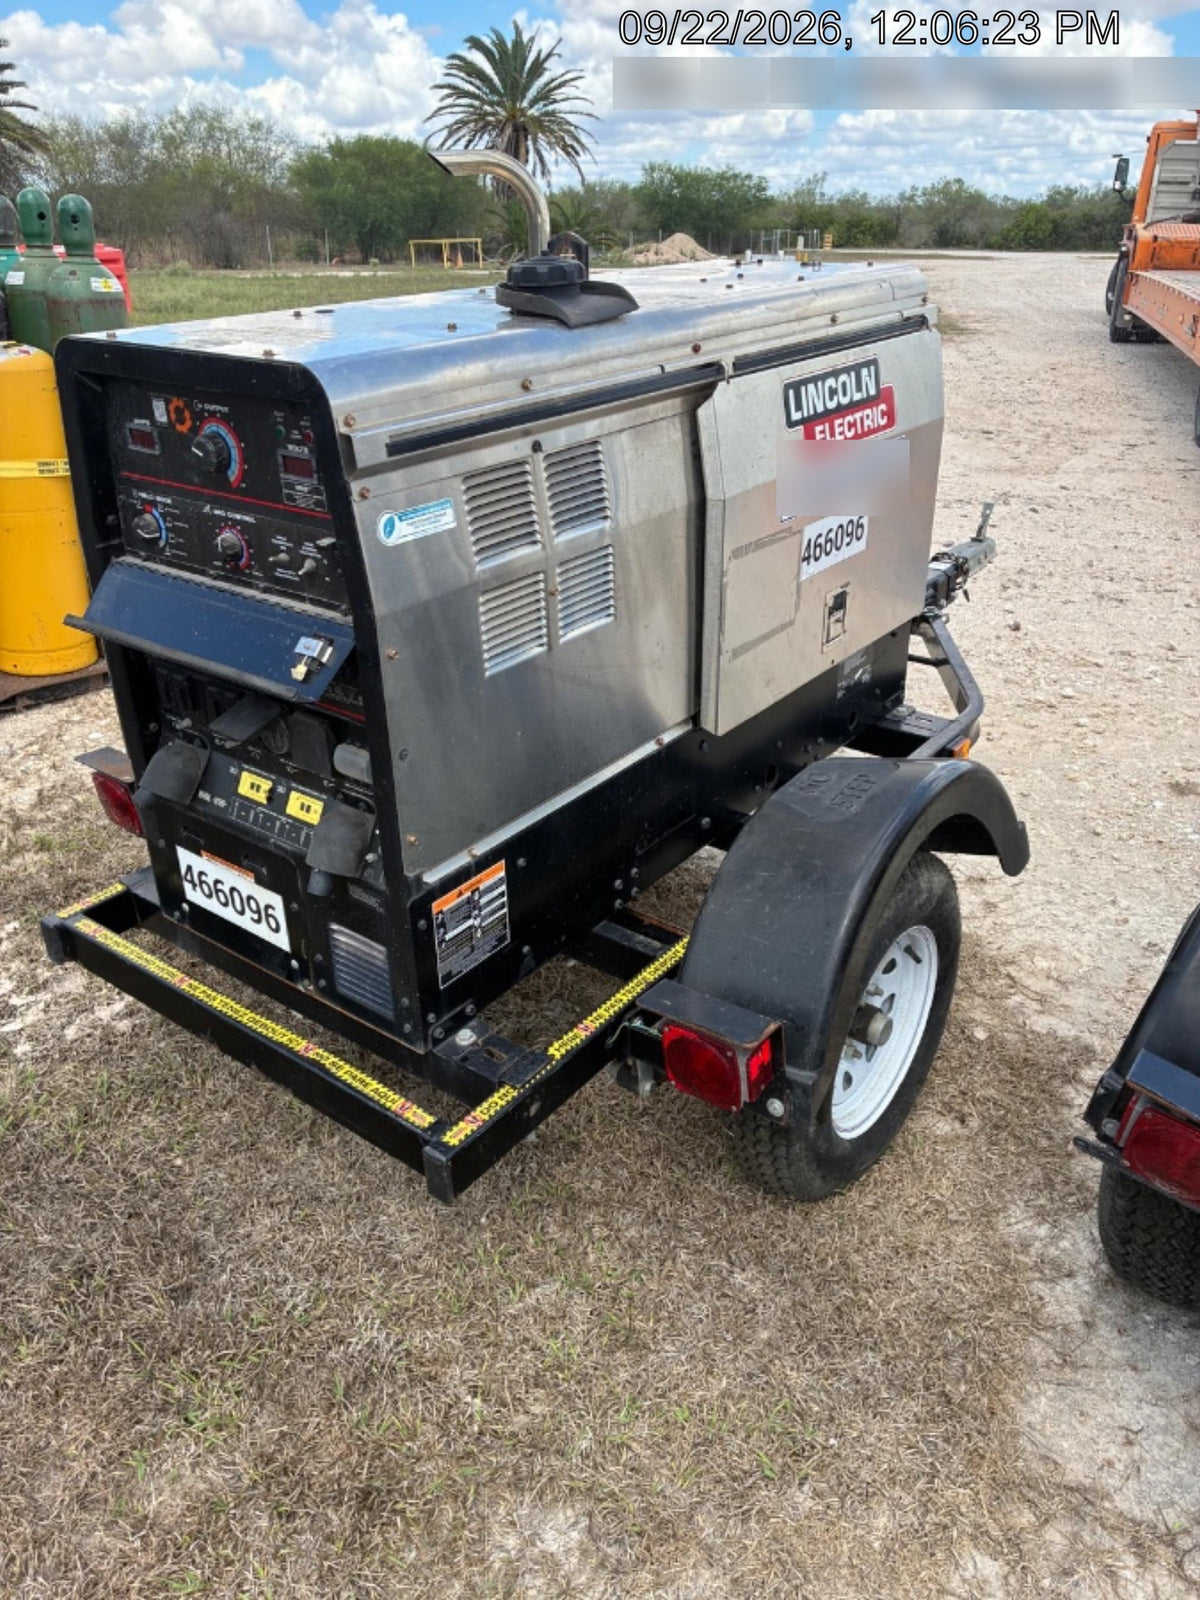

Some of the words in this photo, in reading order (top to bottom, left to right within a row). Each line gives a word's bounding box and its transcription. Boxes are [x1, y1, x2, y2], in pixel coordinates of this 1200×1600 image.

[788, 365, 877, 422] LINCOLN
[813, 403, 889, 441] ELECTRIC
[800, 516, 865, 566] 466096
[183, 864, 281, 934] 466096
